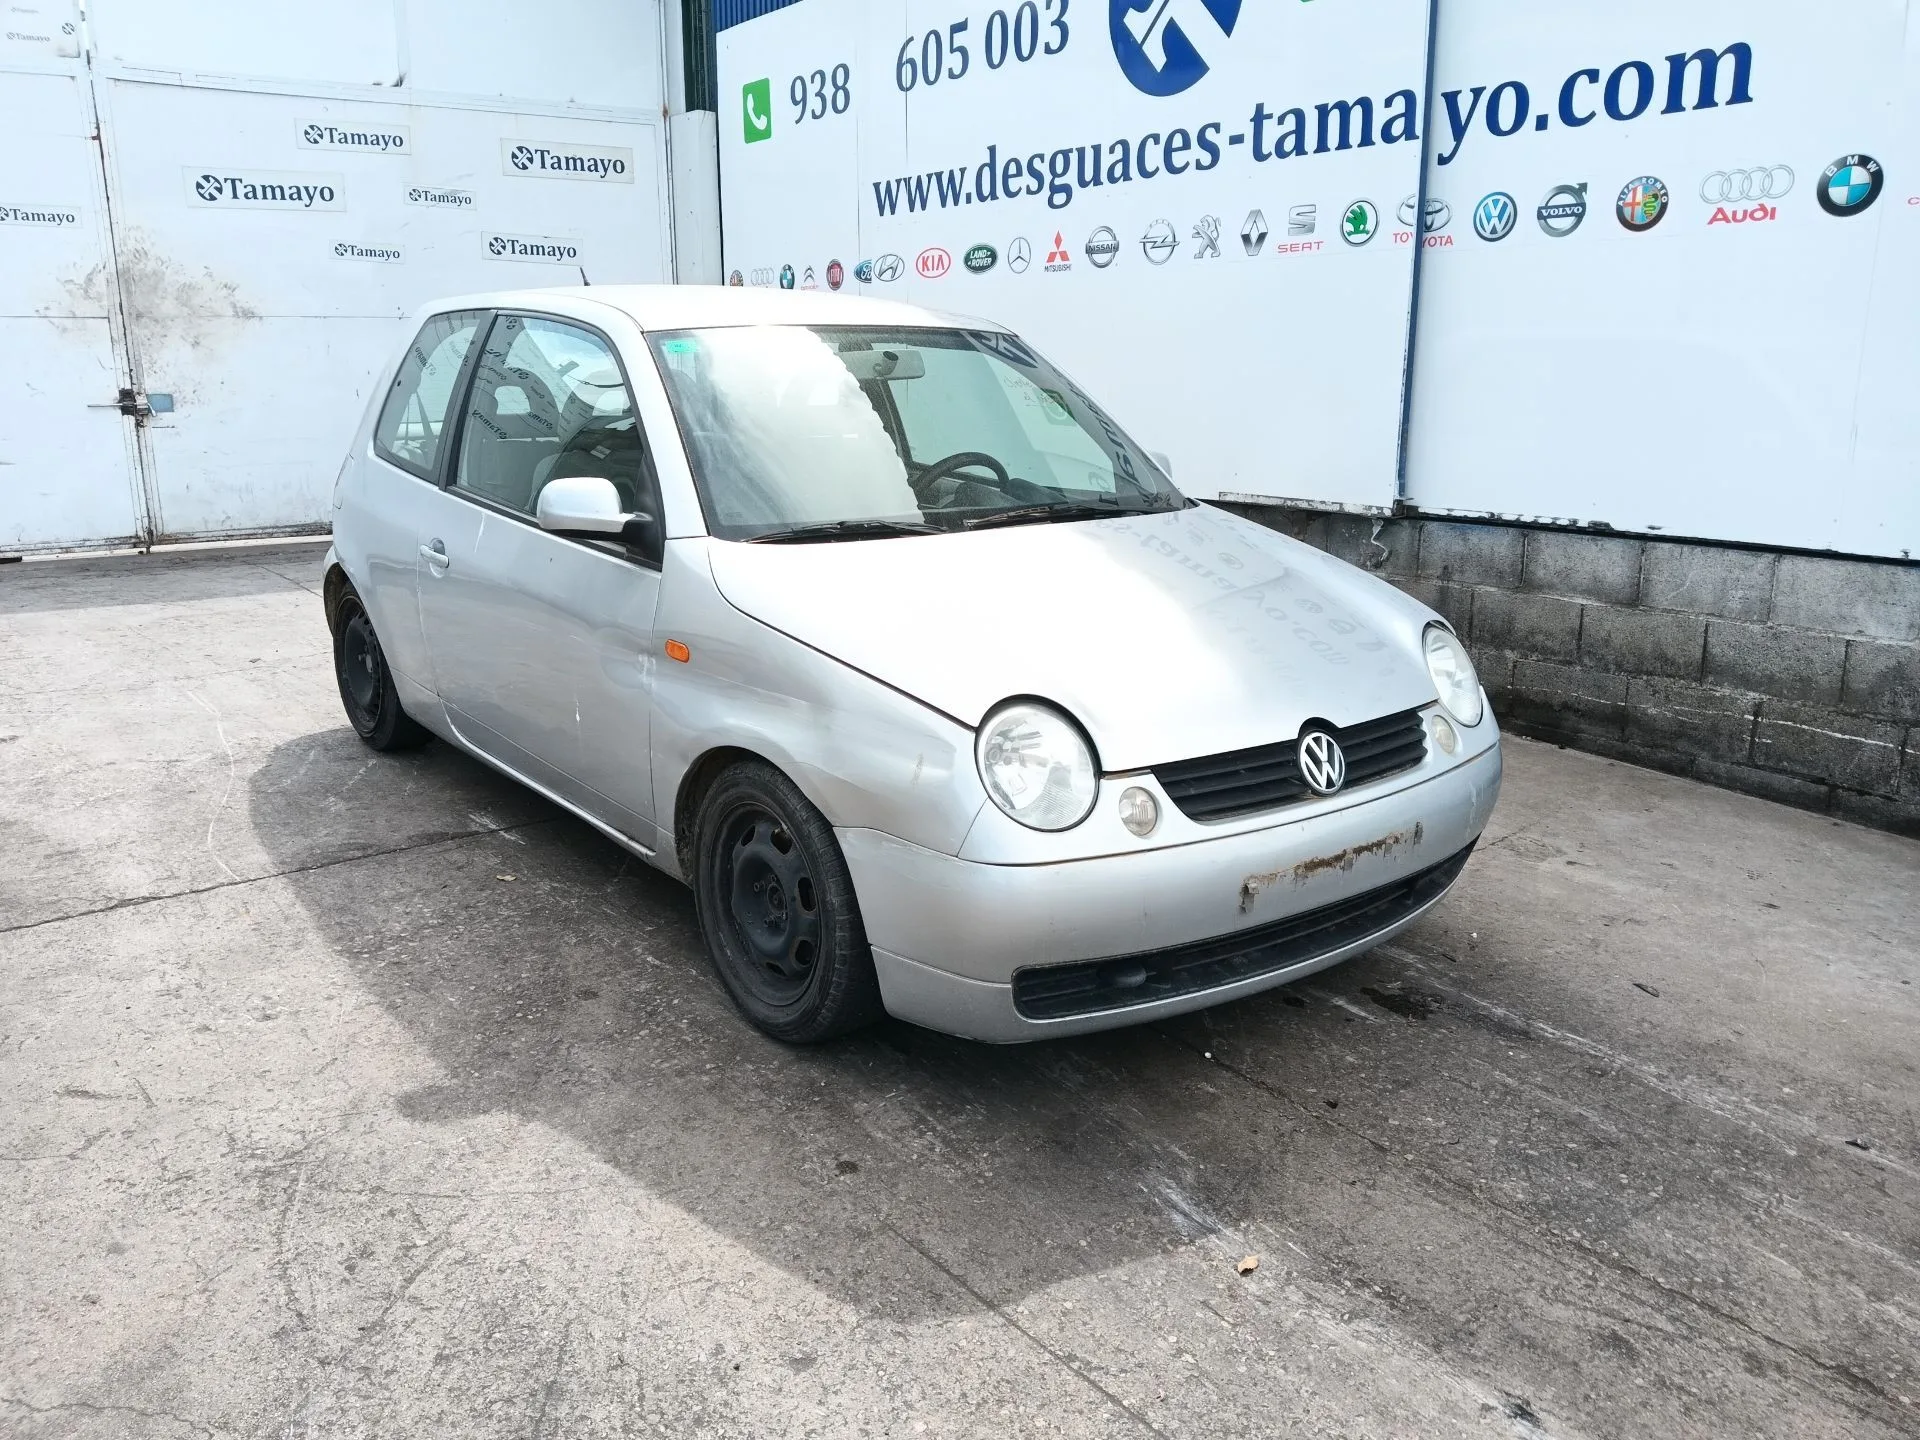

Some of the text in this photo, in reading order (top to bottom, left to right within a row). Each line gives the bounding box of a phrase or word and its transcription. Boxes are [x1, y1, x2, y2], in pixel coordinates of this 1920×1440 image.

[790, 0, 1069, 124] 938 605 003
[324, 127, 404, 151] Tamayo
[873, 42, 1753, 217] www.desguaces-tamayo.com
[535, 149, 626, 179] Tamayo
[1825, 154, 1879, 177] BMW
[224, 177, 335, 208] Tamayo
[422, 190, 472, 207] Tamayo
[1617, 177, 1668, 206] ALFA ROMEO
[9, 208, 76, 226] Tamayo
[1540, 205, 1583, 217] VOLVO
[1707, 204, 1777, 225] Audi
[347, 244, 401, 261] Tamayo
[507, 239, 577, 261] Tamayo
[1089, 243, 1118, 253] NISSAN
[1277, 240, 1324, 254] SEAT
[921, 254, 945, 272] KIA
